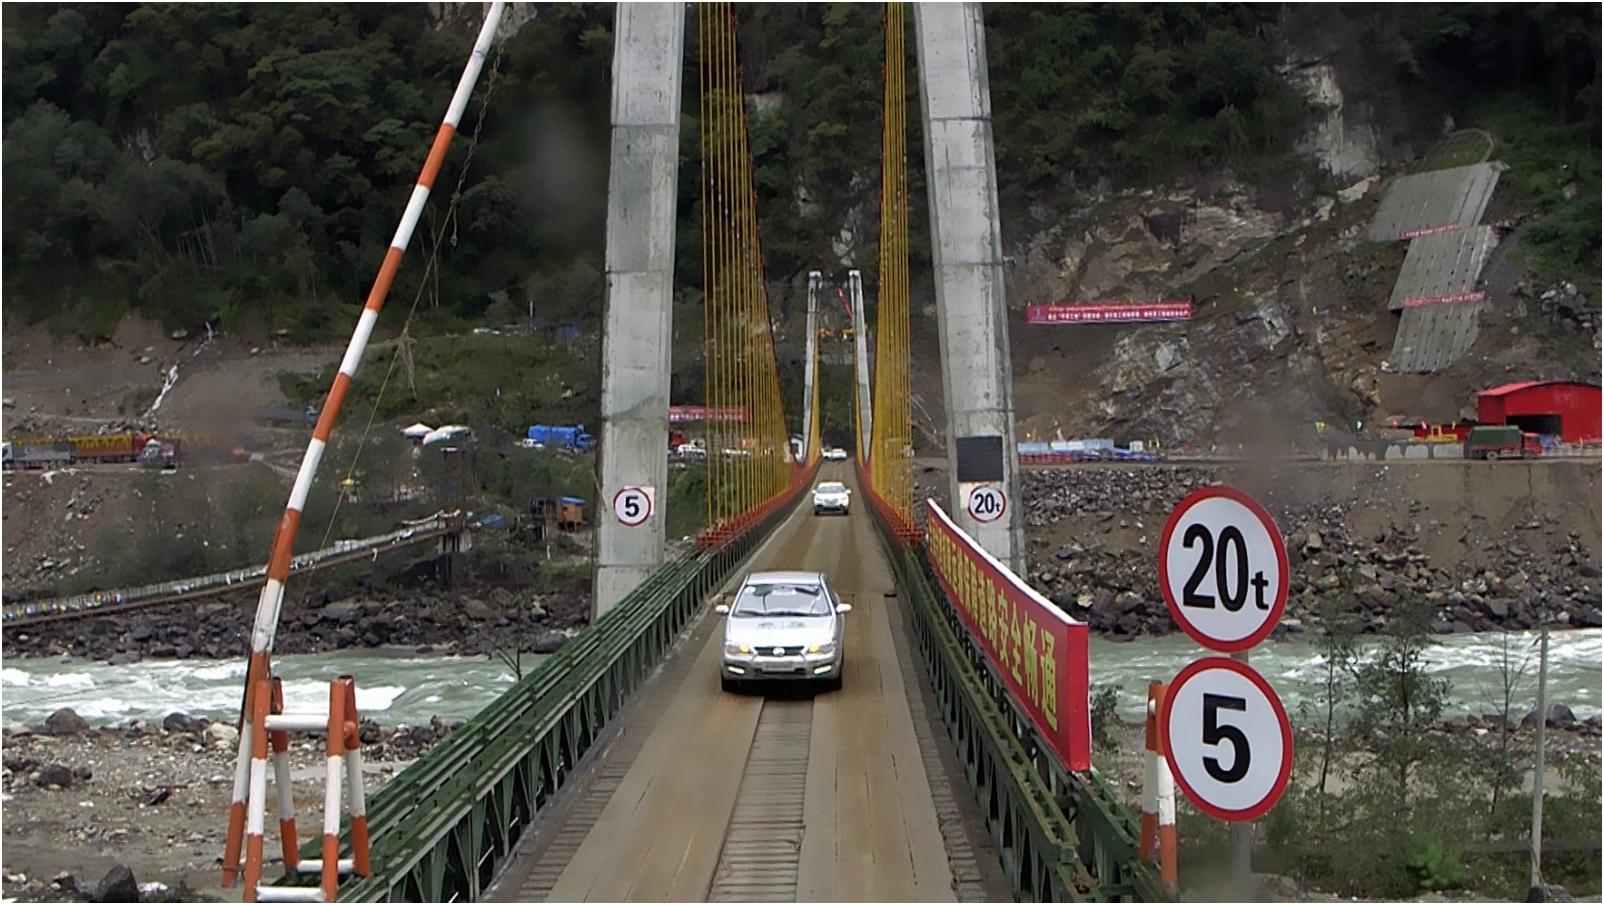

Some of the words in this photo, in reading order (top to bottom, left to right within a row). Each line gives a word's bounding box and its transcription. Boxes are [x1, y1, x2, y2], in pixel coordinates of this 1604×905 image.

[625, 495, 640, 517] 5
[974, 493, 1001, 514] 20t
[1182, 523, 1270, 613] 20t
[1202, 692, 1251, 784] 5
